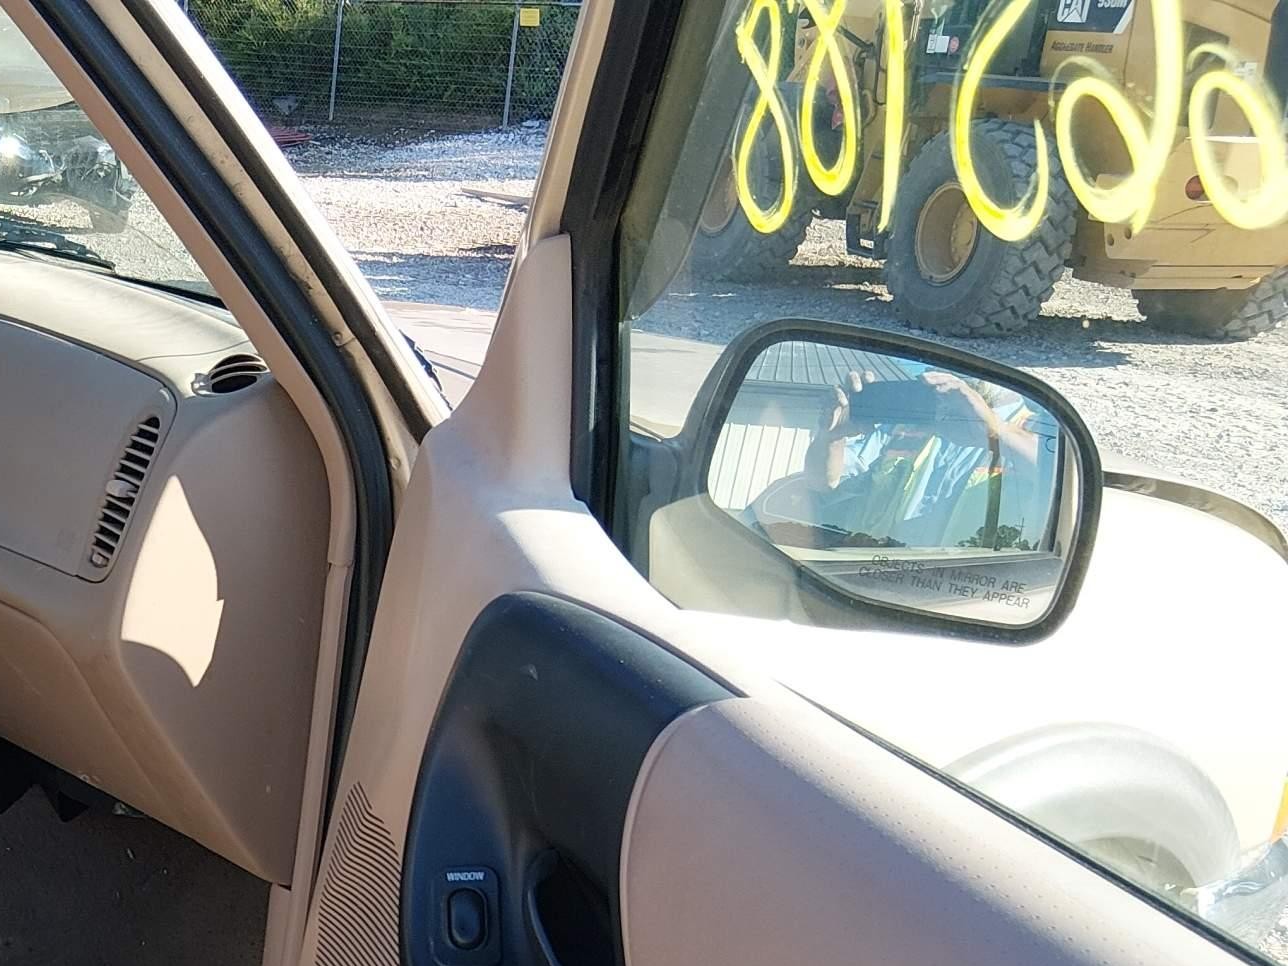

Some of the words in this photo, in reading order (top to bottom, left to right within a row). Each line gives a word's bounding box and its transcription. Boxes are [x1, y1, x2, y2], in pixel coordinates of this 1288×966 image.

[859, 566, 905, 584] CLOSER
[911, 575, 943, 592] THAN
[948, 583, 978, 599] THEY
[983, 592, 1031, 609] APPEAR
[872, 554, 925, 573] OBJECTS
[931, 567, 944, 579] IN
[951, 569, 997, 588] MIRROR
[1002, 580, 1028, 593] ARE
[446, 871, 486, 882] WINDOW
